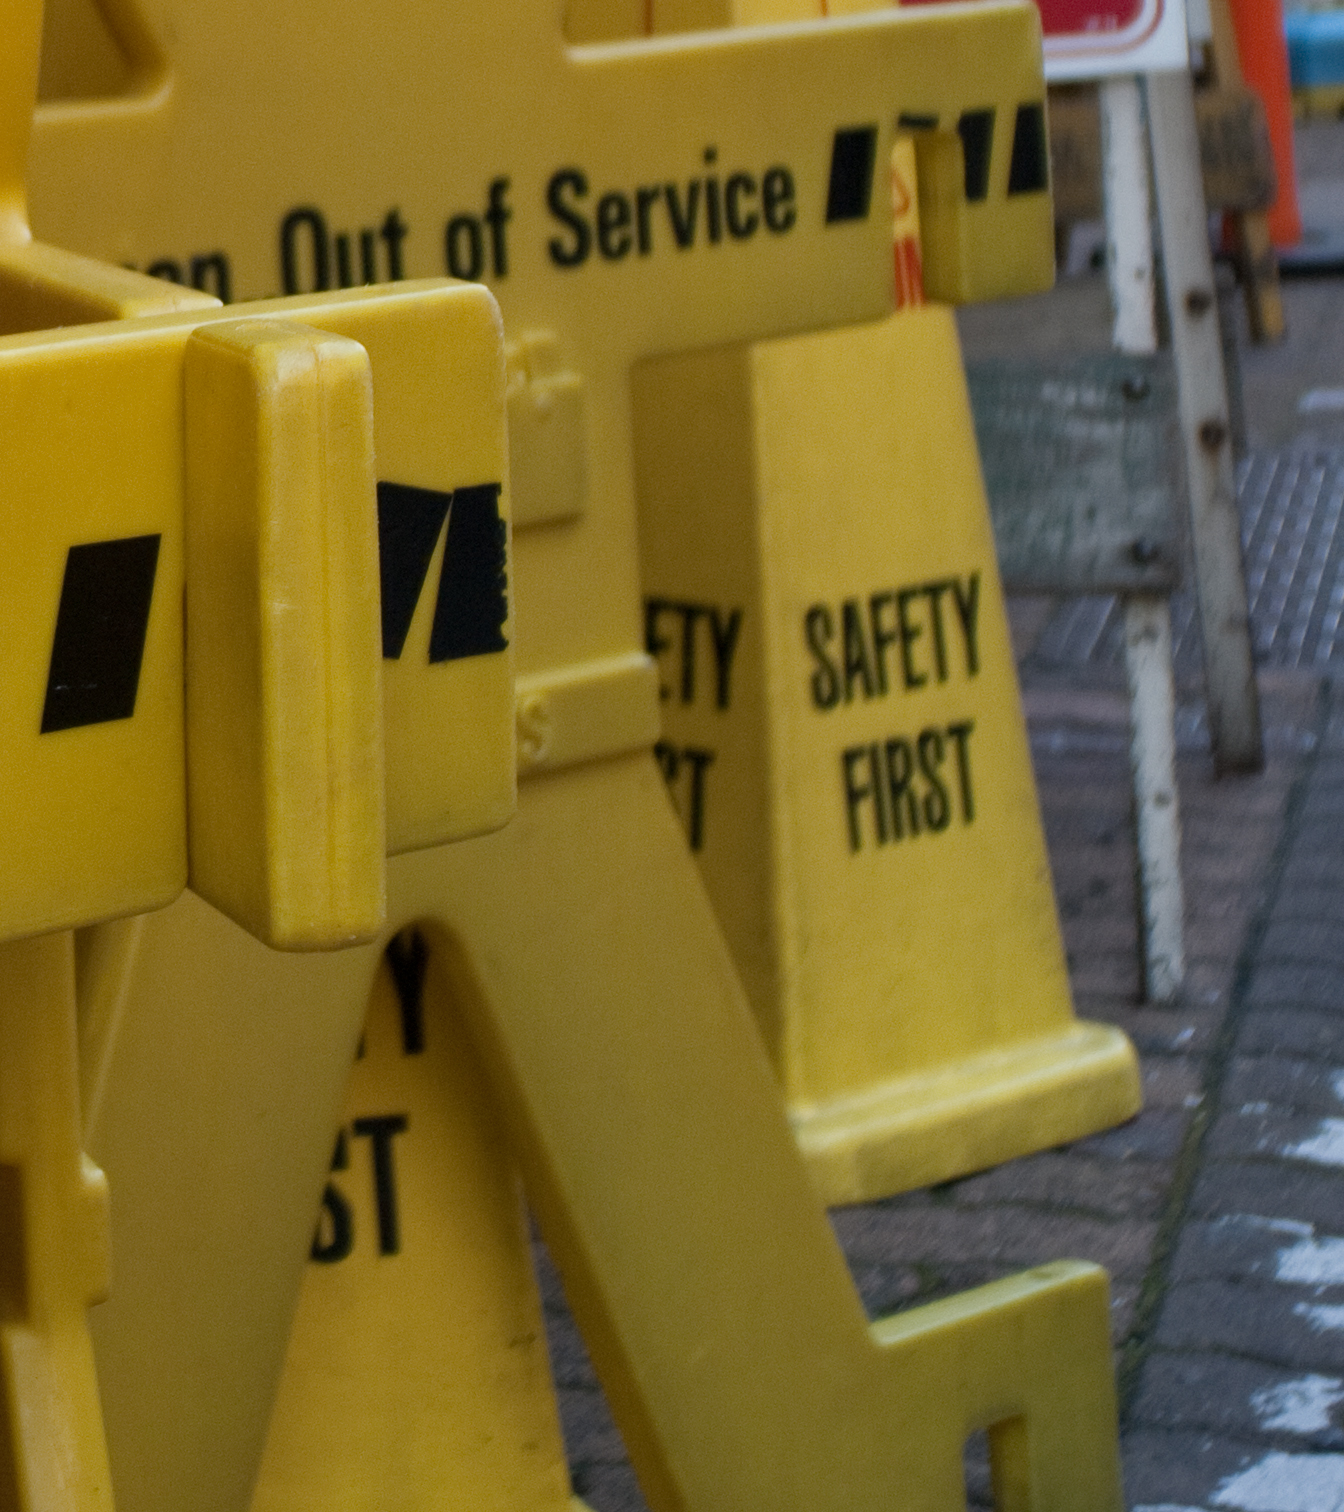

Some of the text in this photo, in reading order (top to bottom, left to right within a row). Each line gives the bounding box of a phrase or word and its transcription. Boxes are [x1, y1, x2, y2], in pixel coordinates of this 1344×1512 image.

[279, 202, 408, 295] Out
[445, 176, 512, 281] of
[547, 145, 796, 268] Service
[804, 570, 982, 714] SAFETY
[841, 718, 976, 856] FIRST
